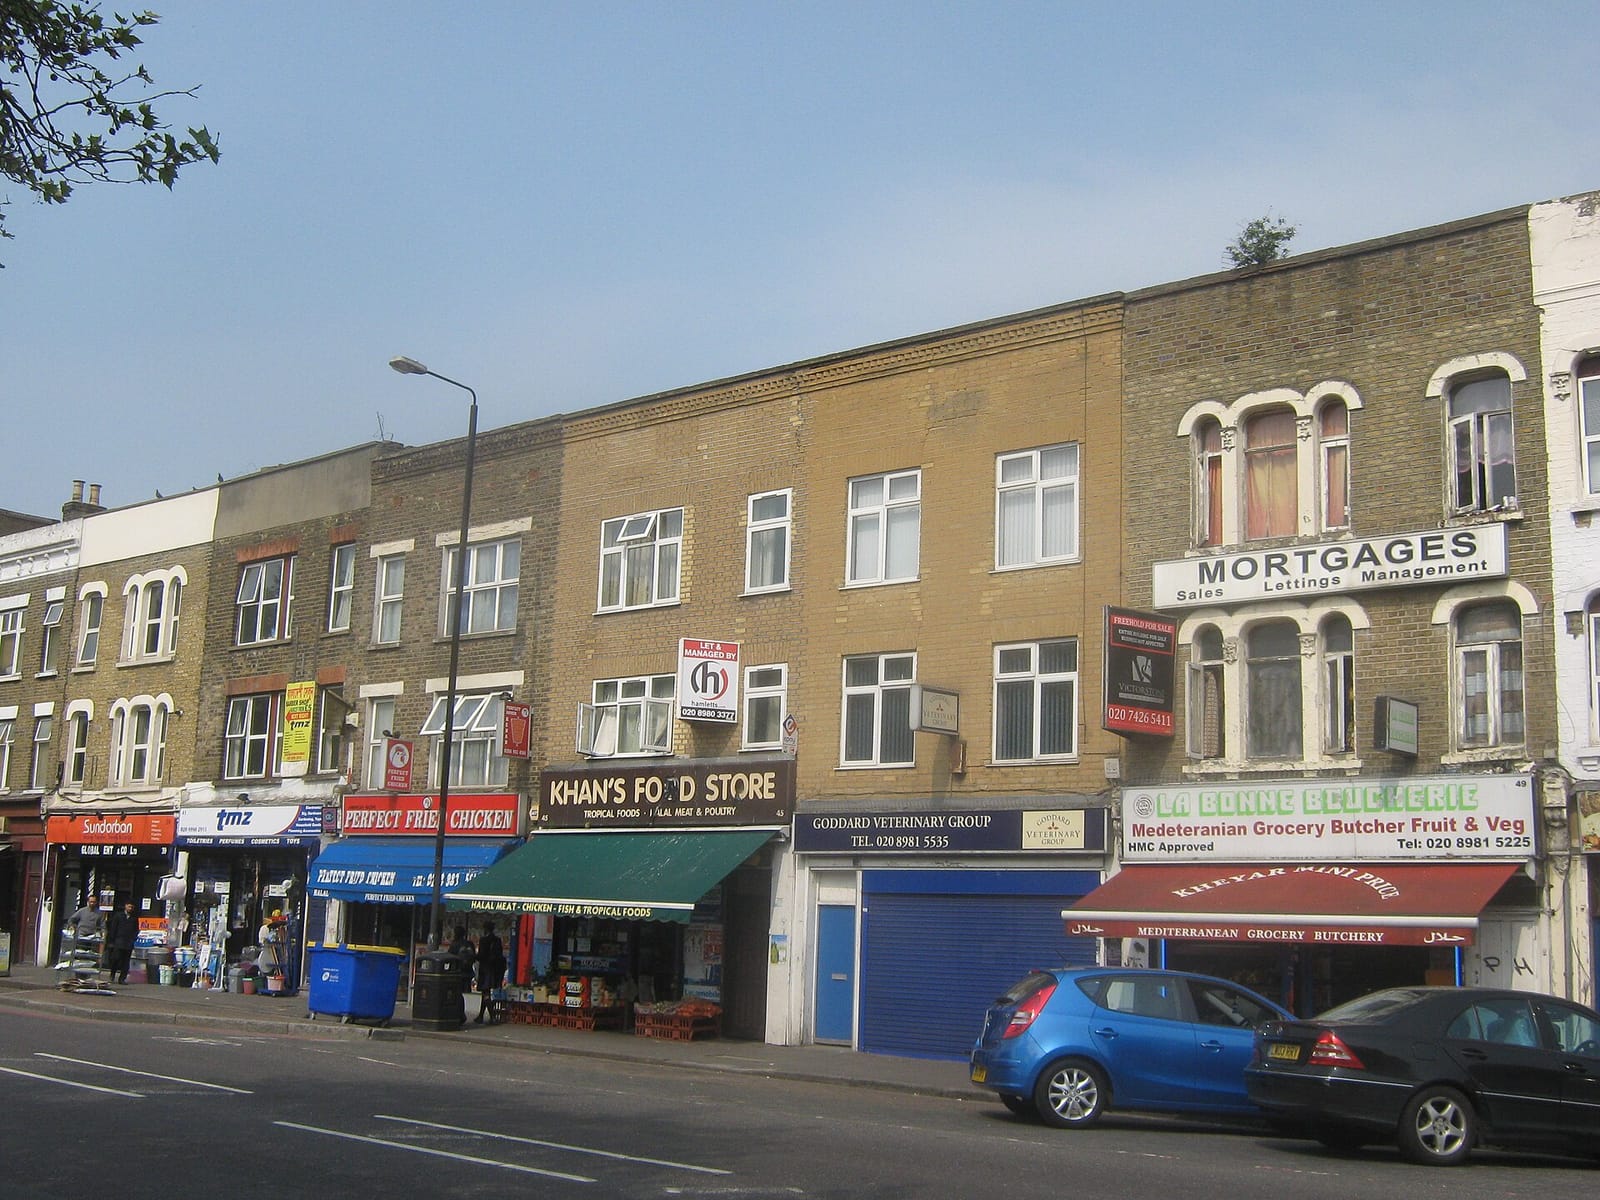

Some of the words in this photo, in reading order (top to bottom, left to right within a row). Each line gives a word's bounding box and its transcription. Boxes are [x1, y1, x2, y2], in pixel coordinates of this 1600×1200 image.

[1199, 532, 1477, 584] MORTGAGES
[1176, 588, 1224, 601] Sales
[1264, 577, 1341, 592] Lettings
[1361, 560, 1488, 582] Management
[1114, 616, 1145, 629] FREEHOLD
[1145, 622, 1157, 630] FOR
[1157, 623, 1172, 633] SALE
[700, 642, 714, 650] LET
[684, 649, 725, 659] MANAGED
[726, 652, 737, 660] BY
[682, 708, 696, 716] 020
[697, 709, 715, 718] 8980
[716, 711, 735, 720] 3377
[1108, 707, 1126, 721] 020
[1128, 710, 1149, 723] 7426
[1151, 713, 1171, 726] 5411
[290, 720, 311, 731] tmz
[550, 777, 627, 806] KHAN'S
[634, 776, 696, 803] FOD
[705, 772, 776, 801] STORE
[1515, 780, 1527, 788] 49
[1156, 791, 1190, 818] LA
[1199, 789, 1295, 816] BONNE
[216, 809, 253, 831] tmz
[344, 809, 403, 829] PERFECT
[405, 810, 447, 830] FRIE
[450, 809, 514, 830] CHICKEN
[583, 809, 615, 819] TROPICAL
[617, 808, 641, 818] FOODS
[674, 807, 694, 816] MEAT
[696, 808, 702, 816] &
[704, 806, 737, 817] POULTRY
[1036, 814, 1071, 826] GODDARD
[82, 819, 133, 834] Sundorban
[813, 817, 871, 830] GODDARD
[873, 816, 947, 829] VETERINARY
[948, 815, 992, 828] GROUP
[1131, 822, 1248, 837] Medeteranian
[1252, 820, 1325, 838] Grocery
[1330, 818, 1405, 834] Butcher
[1411, 816, 1457, 832] Fruit
[1464, 816, 1479, 831] &
[1485, 816, 1525, 835] Veg
[851, 835, 874, 847] TEL.
[876, 836, 894, 847] 020
[896, 835, 920, 848] 8981
[923, 835, 949, 848] 5535
[1026, 830, 1081, 838] VETERINARY
[81, 845, 100, 855] GLOBAL
[1128, 842, 1155, 852] HMC
[1158, 842, 1214, 854] Approved
[1397, 838, 1422, 849] Tel:
[1426, 838, 1451, 849] 020
[1456, 837, 1490, 848] 8981
[1495, 836, 1531, 848] 5225
[1171, 867, 1286, 898] KHEYAR
[1293, 866, 1358, 878] MINI
[1354, 872, 1401, 900] PRICE
[471, 900, 495, 910] HALAL
[496, 901, 517, 911] MEAT
[522, 902, 552, 913] CHICKEN
[558, 904, 575, 914] FISH
[575, 905, 582, 914] &
[583, 905, 621, 917] TROPICAL
[622, 907, 651, 918] FOODS
[1138, 927, 1239, 938] MEDITERRANEAN
[1247, 929, 1305, 940] GROCERY
[1314, 931, 1385, 942] BUTCHERY
